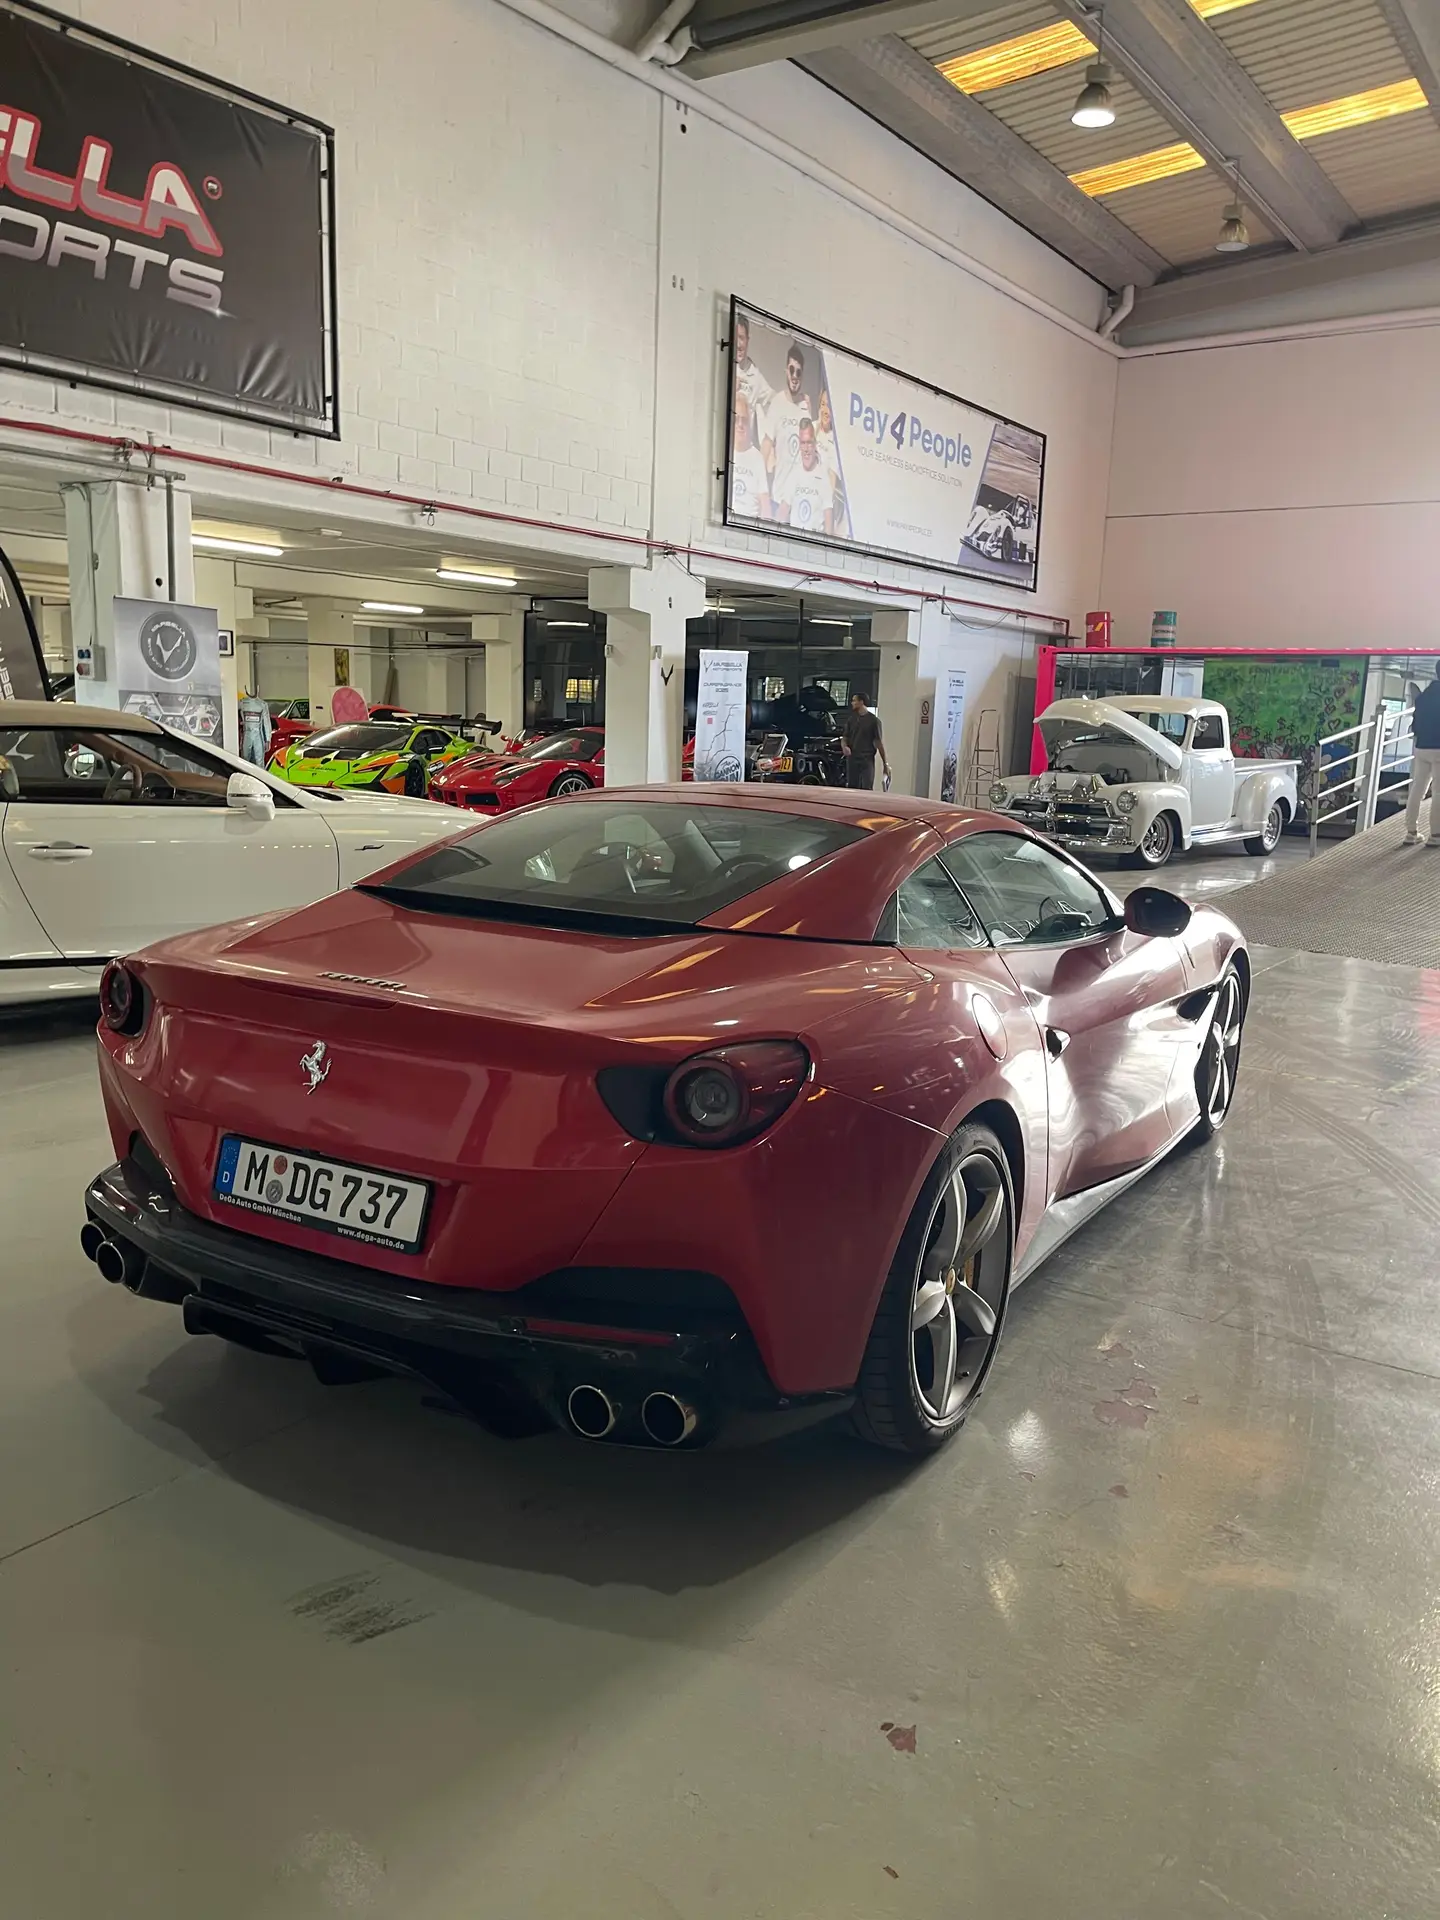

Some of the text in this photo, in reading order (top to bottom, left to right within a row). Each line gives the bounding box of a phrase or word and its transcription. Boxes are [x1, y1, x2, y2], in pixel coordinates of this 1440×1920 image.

[0, 106, 224, 258] LLA
[849, 391, 972, 469] Pay 4 People
[222, 1171, 230, 1183] D
[244, 1150, 408, 1229] M DG 737
[219, 1193, 302, 1222] DeGa Auto GmbH München
[337, 1226, 405, 1250] www.dega-auto.de
